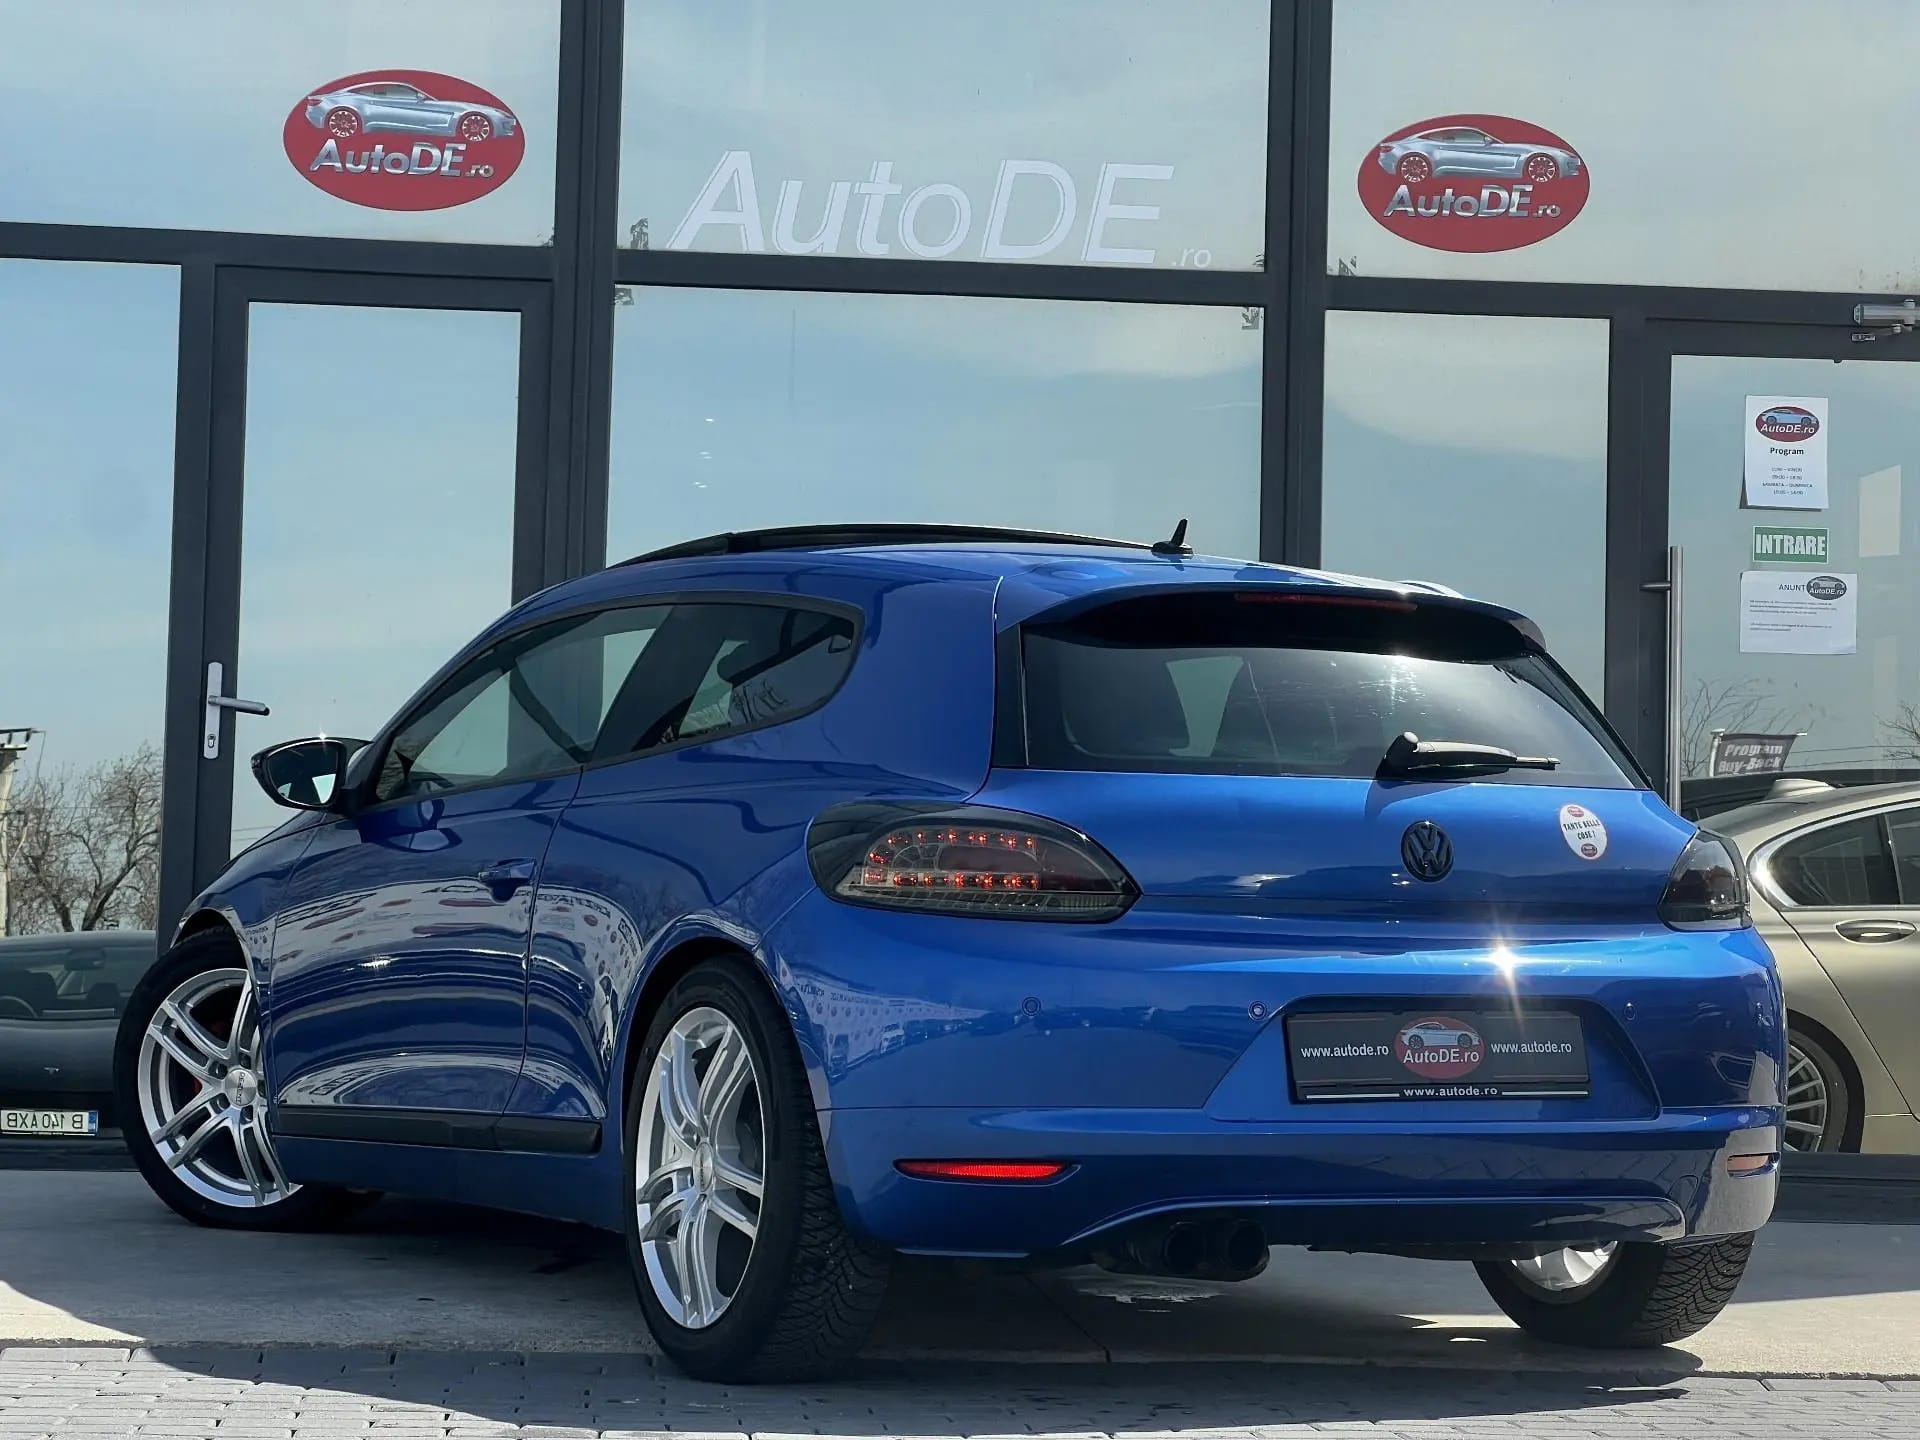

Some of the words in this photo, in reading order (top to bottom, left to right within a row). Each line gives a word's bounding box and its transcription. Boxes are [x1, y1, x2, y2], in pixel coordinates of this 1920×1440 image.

[1760, 423, 1815, 434] AutoDE.ro
[1770, 447, 1804, 456] Program
[1755, 534, 1826, 556] INTRARE
[1809, 587, 1844, 595] AutoDE.ro
[1724, 744, 1783, 757] Program
[1719, 757, 1782, 773] Buy-Back
[1300, 1043, 1389, 1058] www.autode.ro
[1491, 1040, 1572, 1054] www.autode.ro
[1402, 1048, 1480, 1064] AutoDE.ro
[1403, 1086, 1498, 1097] www.autode.ro
